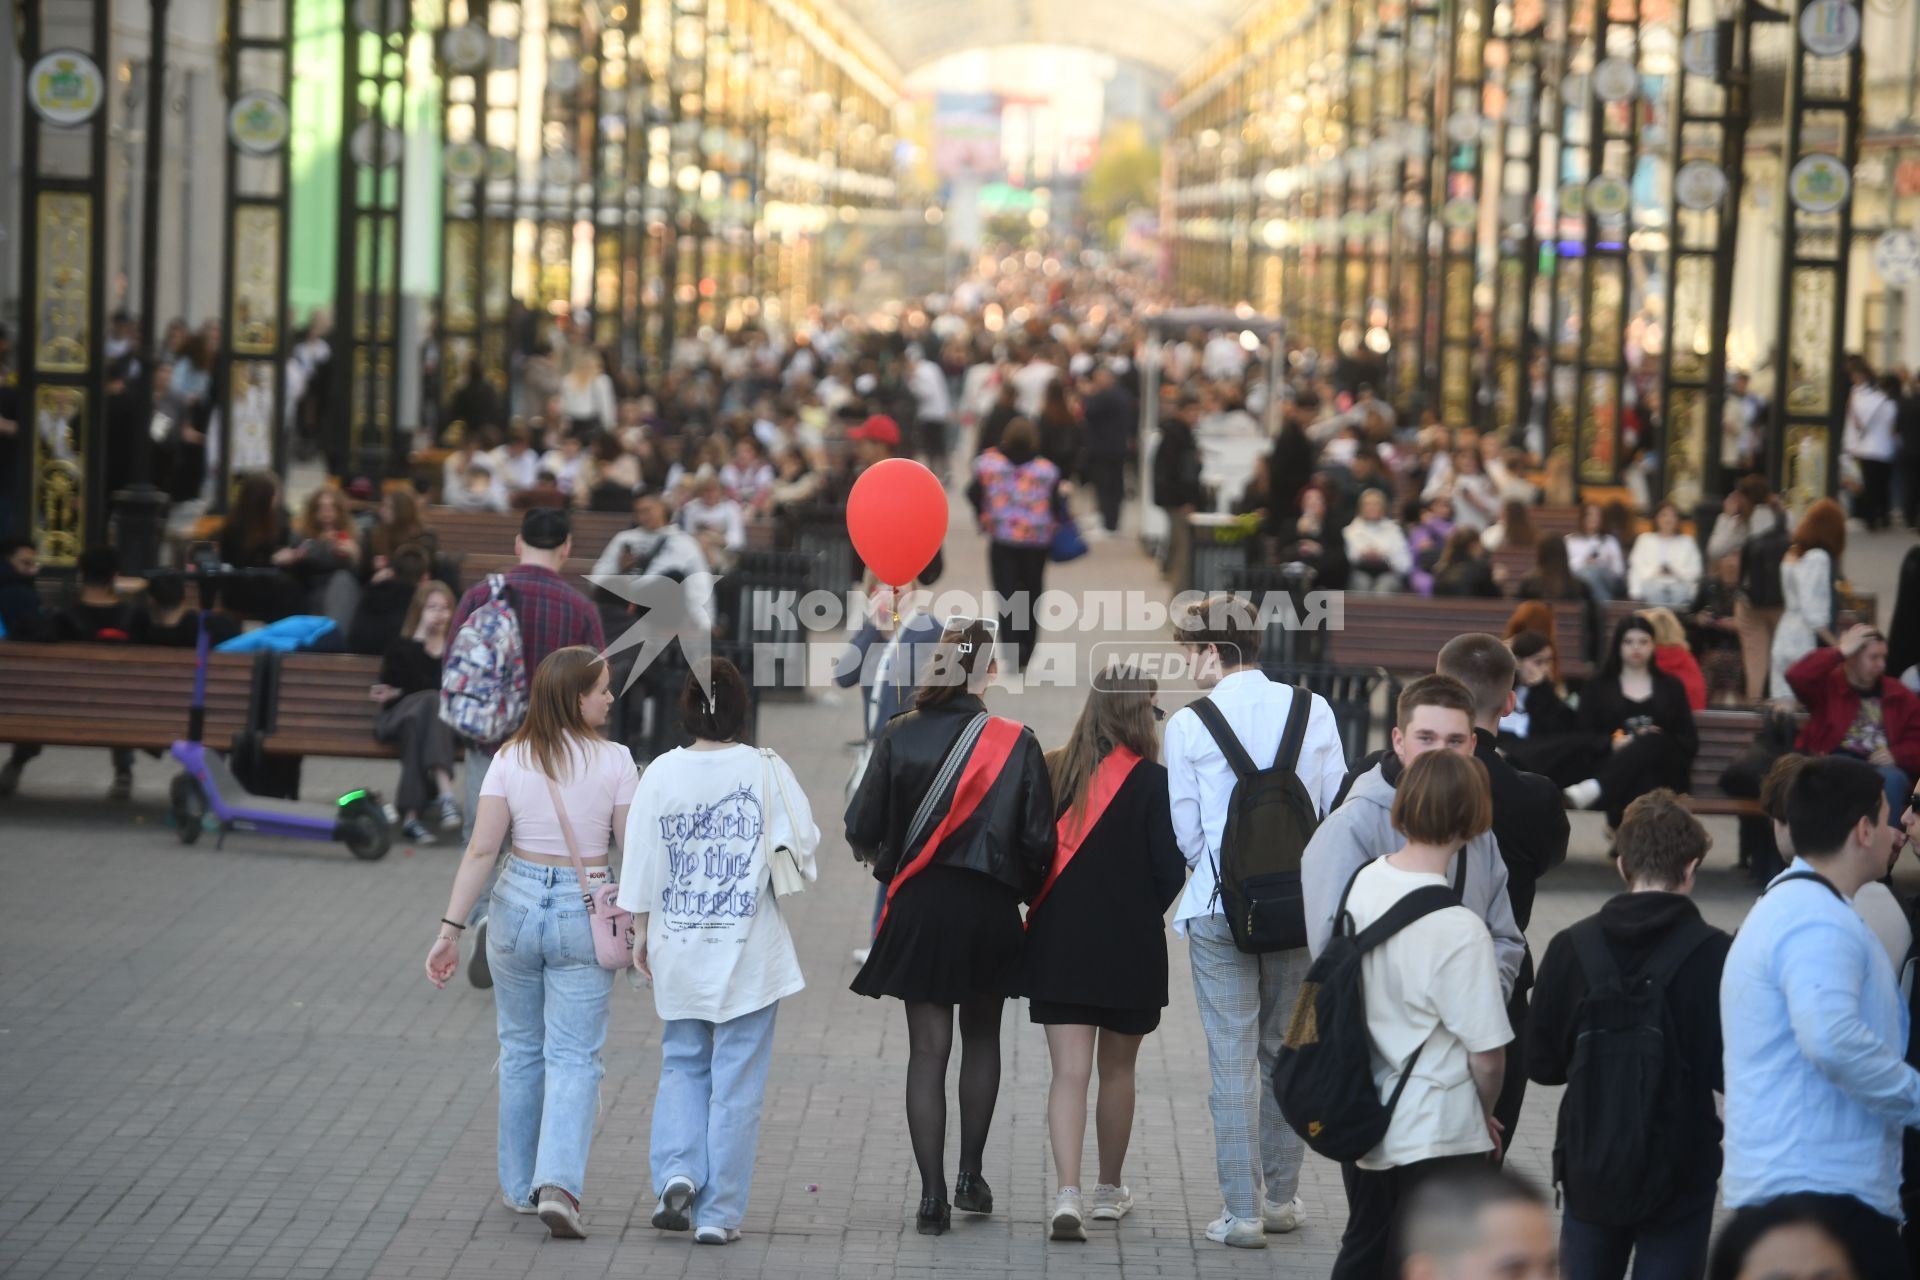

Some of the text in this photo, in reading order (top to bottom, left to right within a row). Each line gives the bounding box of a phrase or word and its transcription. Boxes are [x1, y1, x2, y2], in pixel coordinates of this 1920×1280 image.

[659, 800, 758, 841] raised
[666, 843, 752, 886] by the
[662, 886, 758, 917] streets
